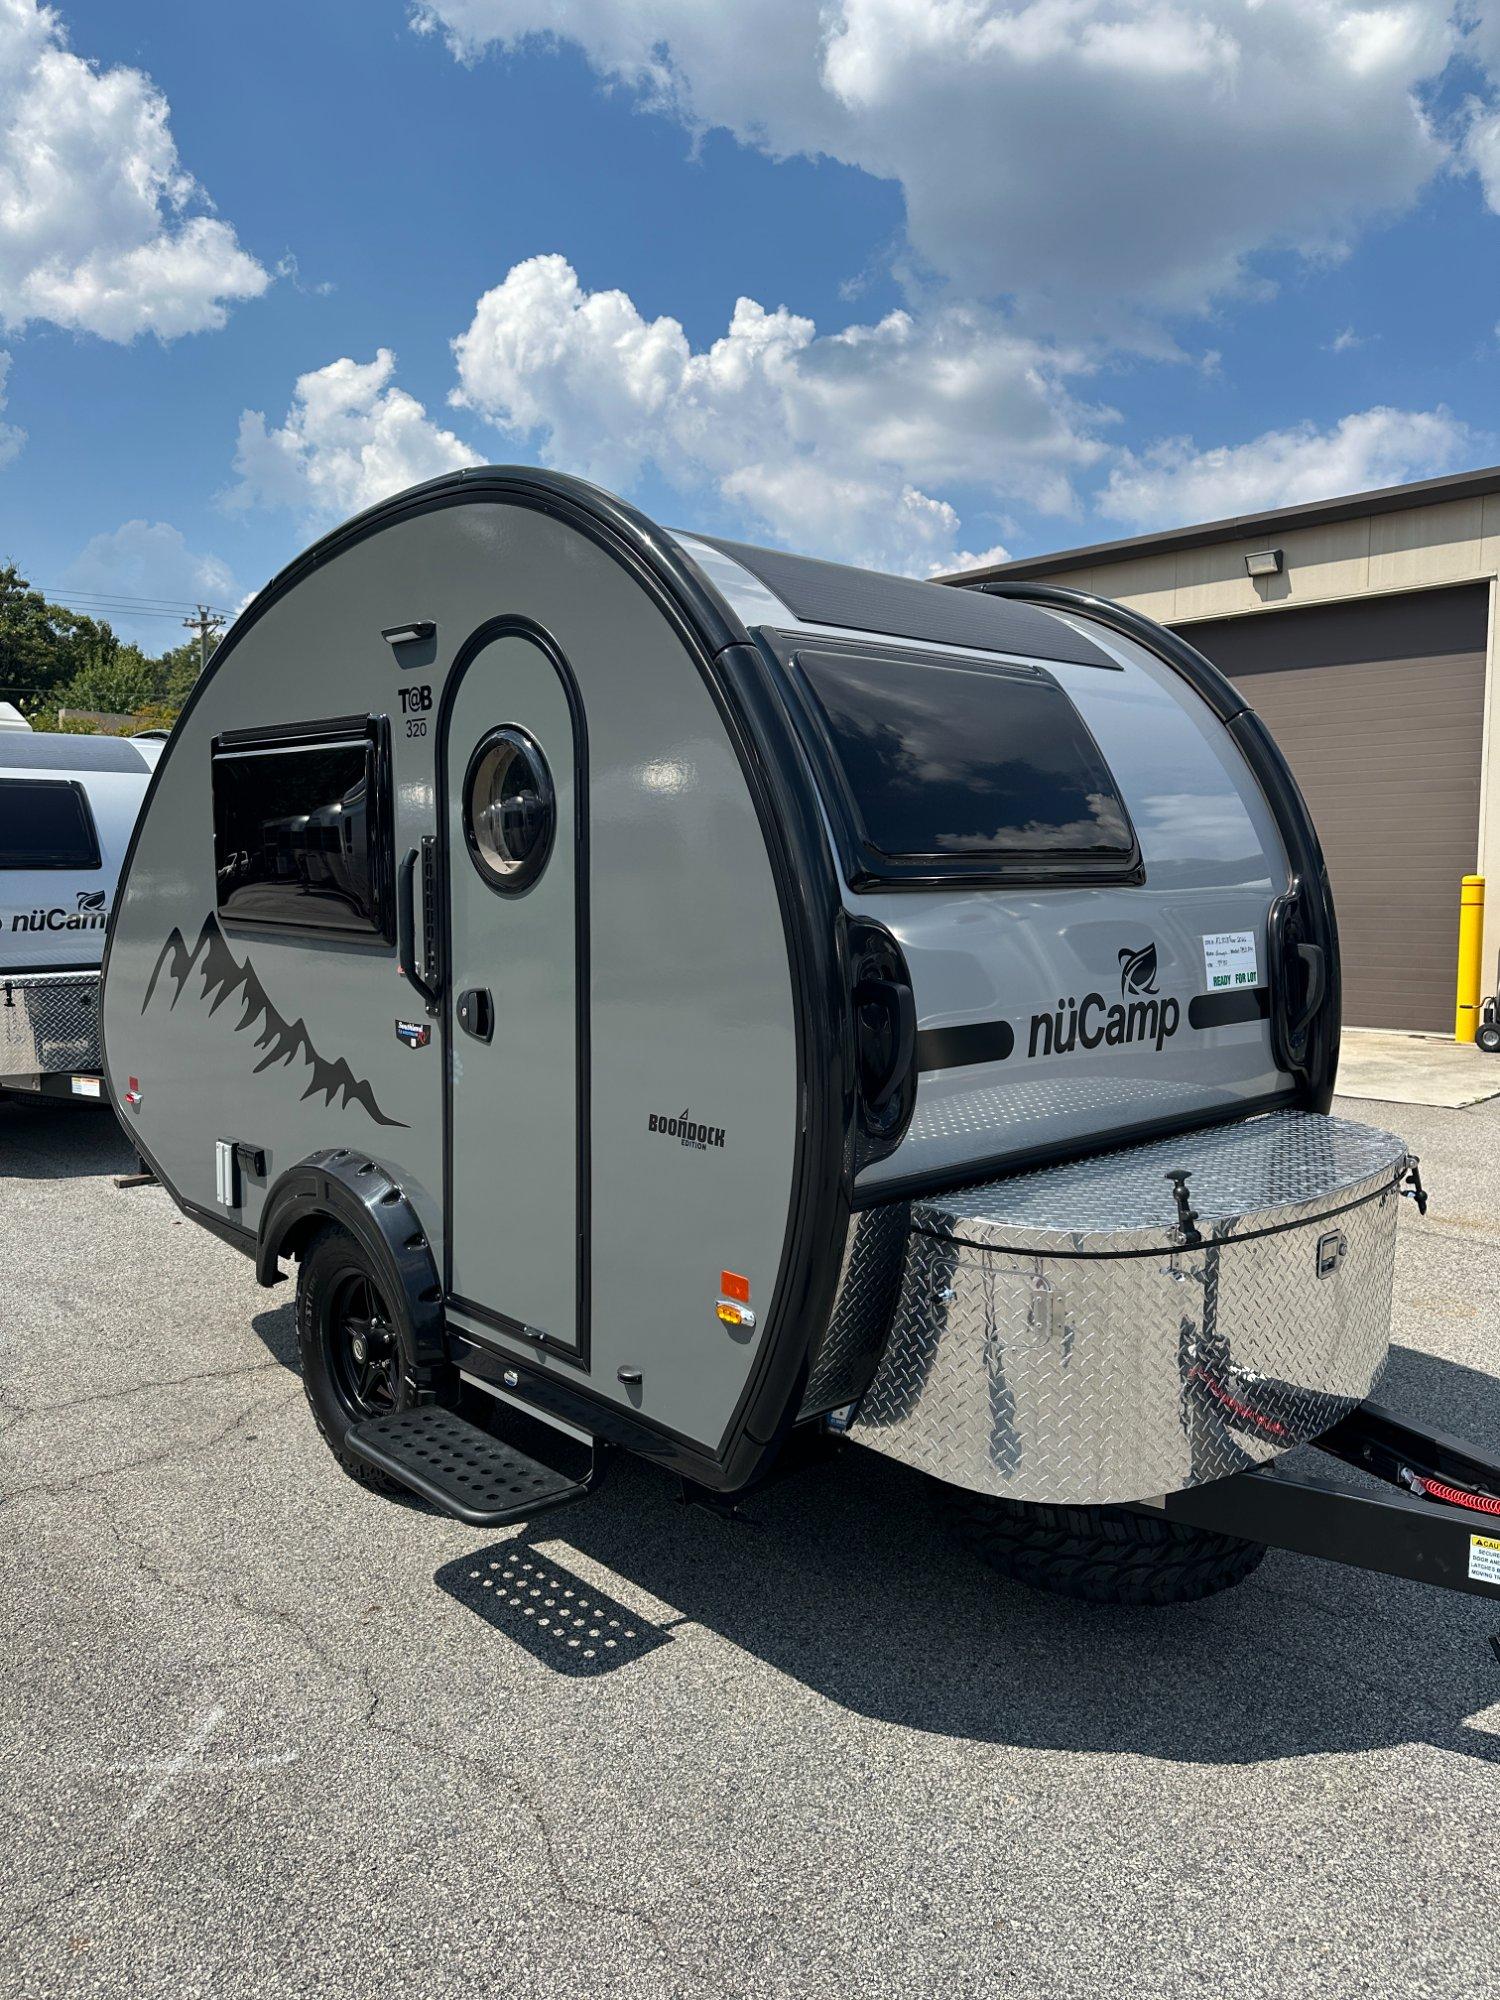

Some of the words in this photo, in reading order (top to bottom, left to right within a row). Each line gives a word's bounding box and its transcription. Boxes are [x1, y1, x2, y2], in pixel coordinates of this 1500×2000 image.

[398, 685, 433, 714] T@B
[406, 719, 427, 738] 320
[1212, 974, 1231, 987] READY
[1235, 972, 1246, 984] FOR
[1247, 971, 1257, 983] LOT
[1028, 992, 1180, 1058] nüCamp
[681, 1139, 707, 1151] EDITION
[1483, 1540, 1500, 1550] CAU
